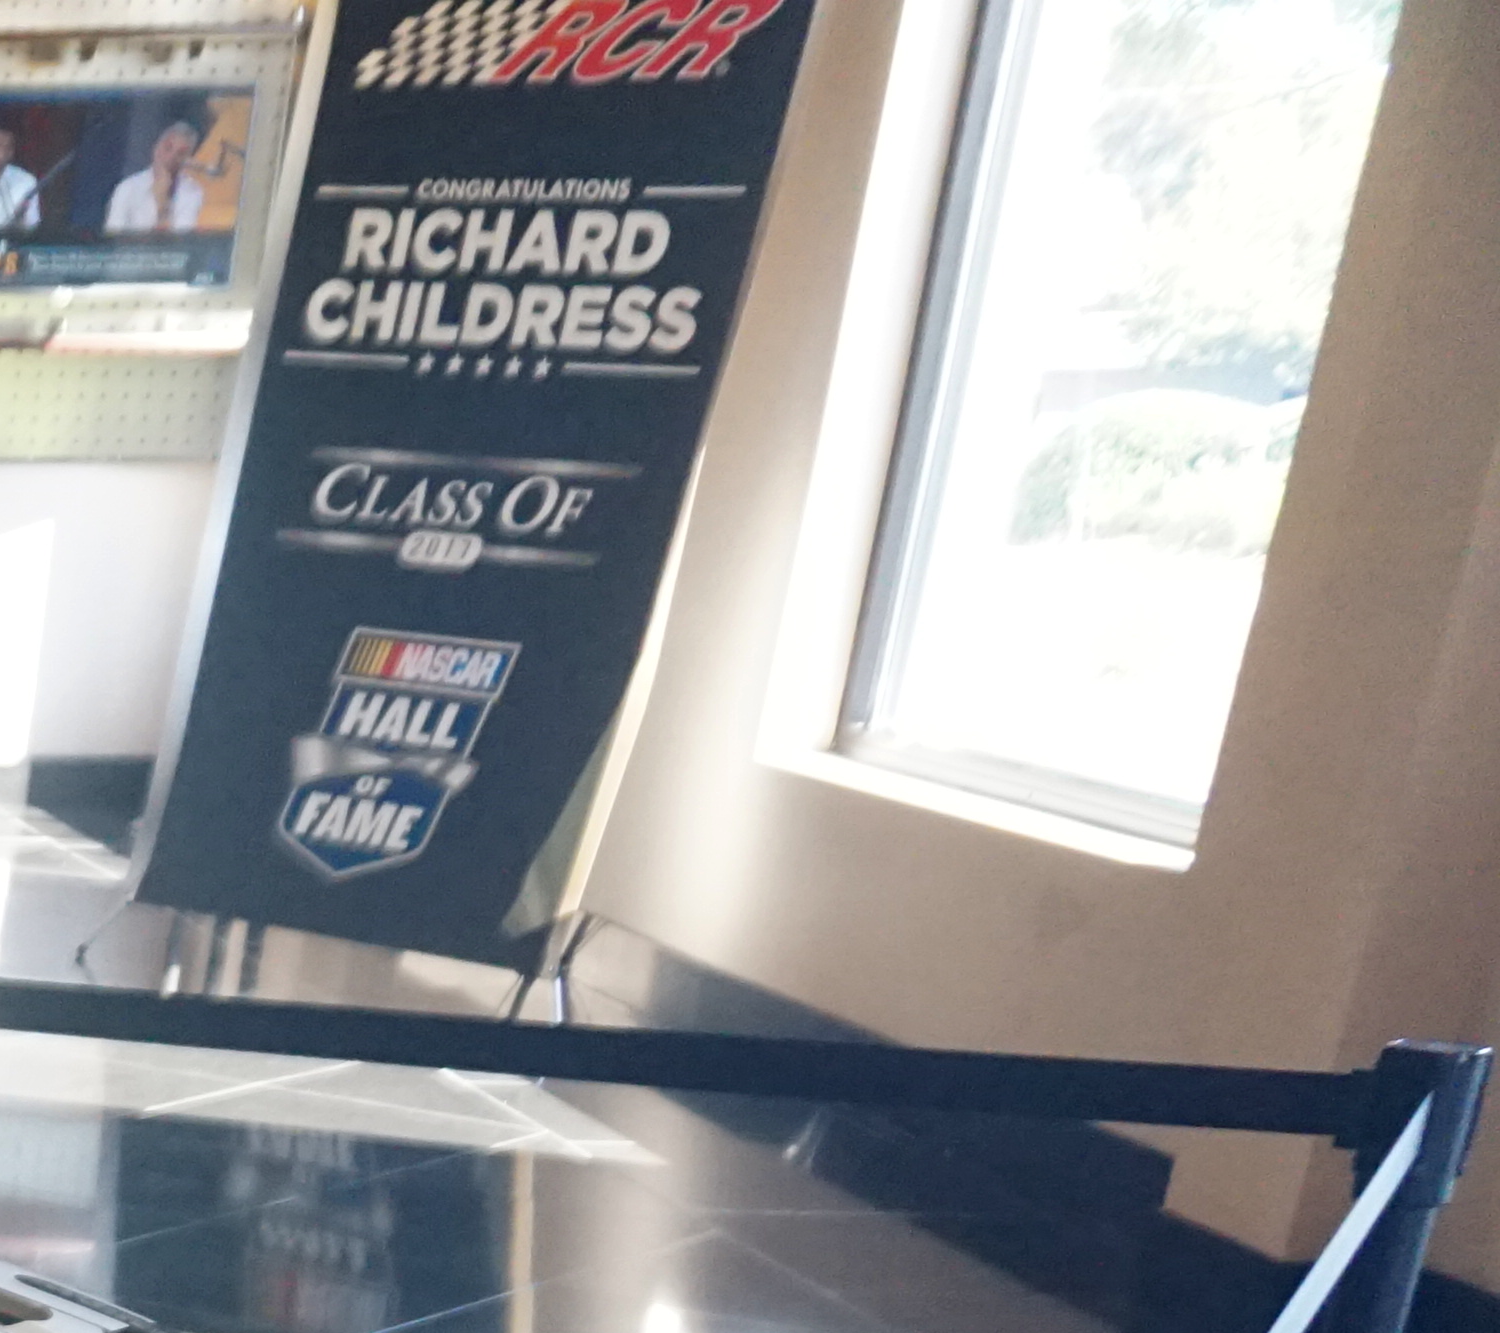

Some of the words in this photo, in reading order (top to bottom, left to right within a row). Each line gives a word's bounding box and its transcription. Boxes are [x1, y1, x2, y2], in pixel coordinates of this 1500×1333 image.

[492, 0, 780, 84] RCR
[416, 178, 633, 202] CONGRATULATIONS
[342, 207, 672, 274] RICHARD
[305, 278, 703, 354] CHILDRESS
[407, 533, 475, 561] 2017
[395, 643, 504, 689] NASCAR
[339, 690, 461, 751] HALL
[353, 774, 392, 795] OF
[295, 791, 425, 853] FAME
